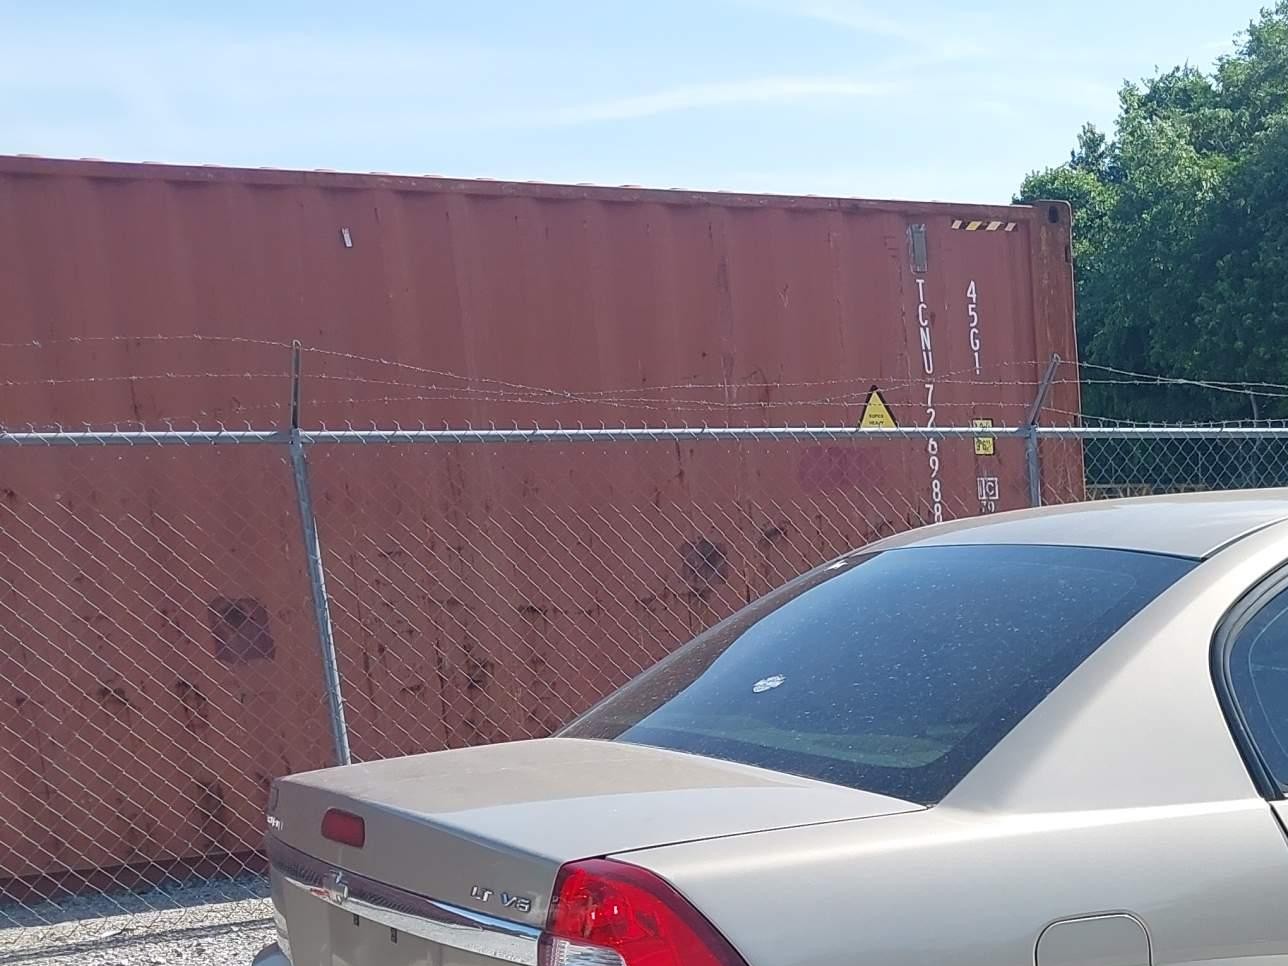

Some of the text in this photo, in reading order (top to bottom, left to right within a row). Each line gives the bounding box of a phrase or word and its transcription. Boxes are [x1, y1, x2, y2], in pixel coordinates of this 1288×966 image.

[915, 278, 934, 374] TCNU
[966, 279, 981, 375] 45G1
[471, 886, 532, 913] LT V6
